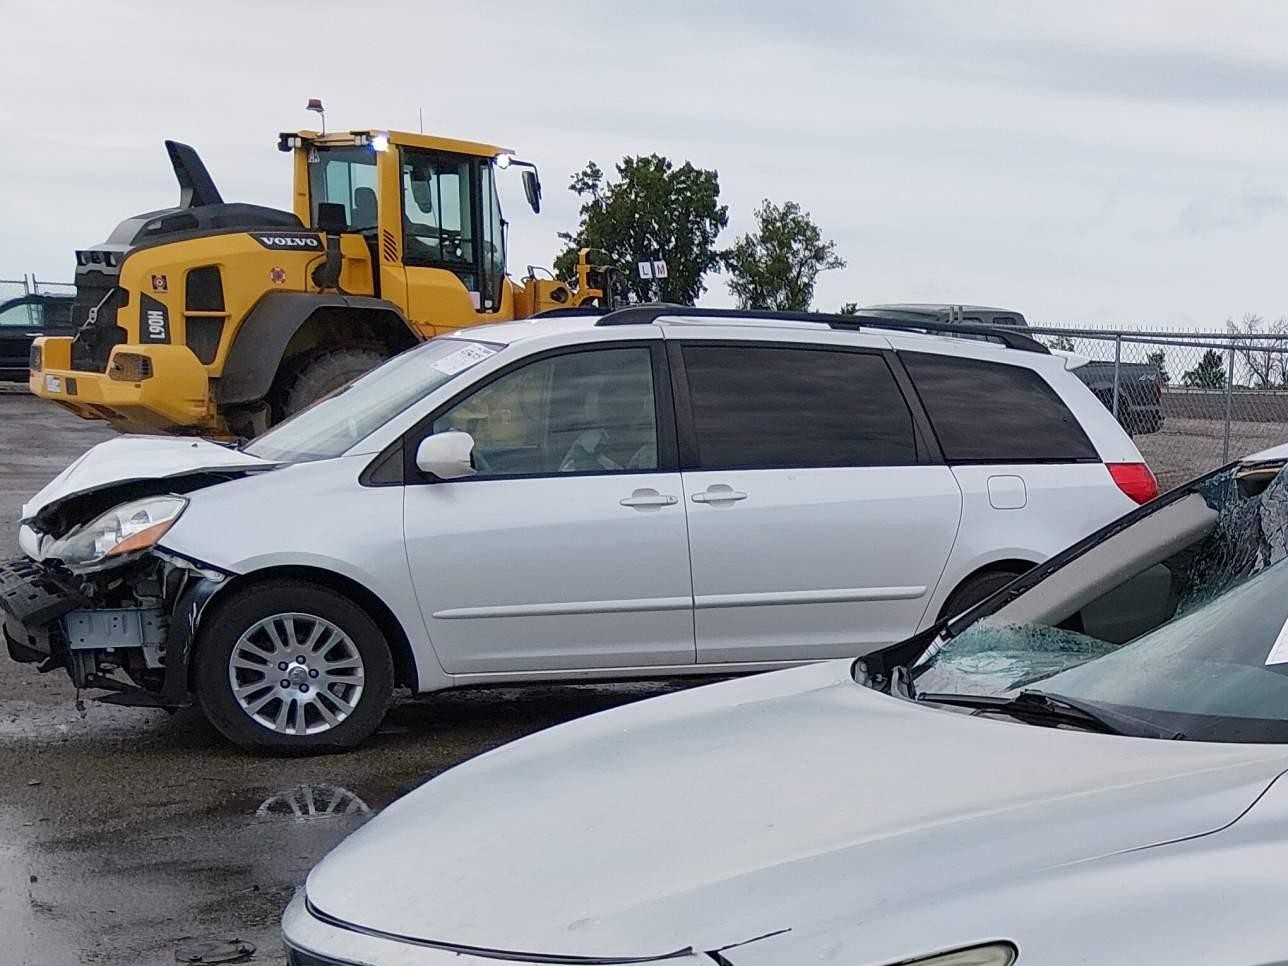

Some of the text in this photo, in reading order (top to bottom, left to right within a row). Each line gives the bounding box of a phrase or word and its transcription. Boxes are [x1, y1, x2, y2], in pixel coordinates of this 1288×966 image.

[260, 237, 318, 246] VOLVO
[642, 265, 649, 275] L
[656, 264, 665, 275] M
[147, 311, 165, 339] L90H
